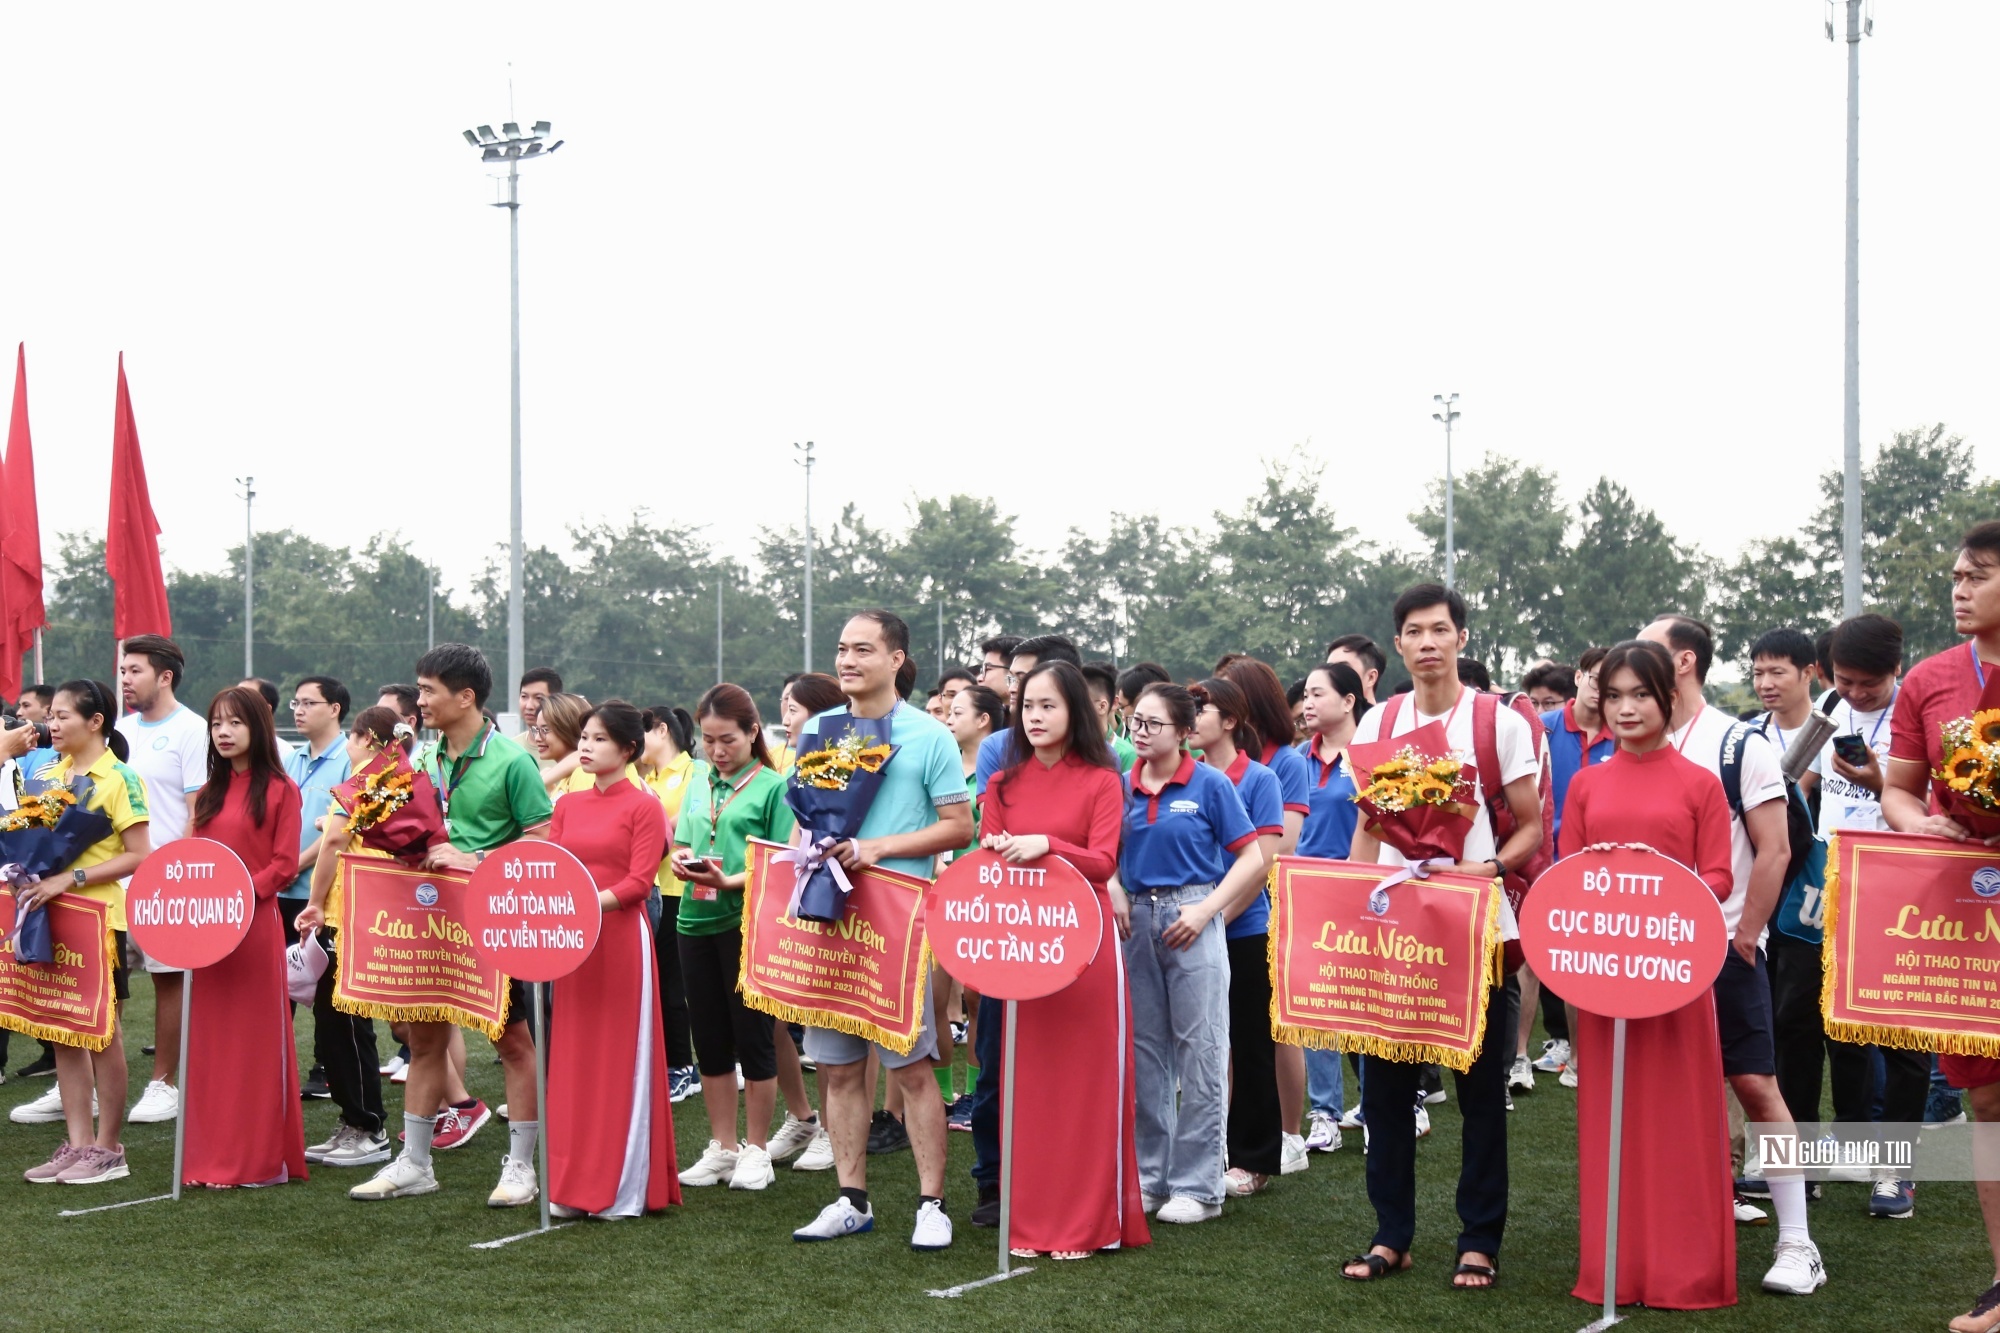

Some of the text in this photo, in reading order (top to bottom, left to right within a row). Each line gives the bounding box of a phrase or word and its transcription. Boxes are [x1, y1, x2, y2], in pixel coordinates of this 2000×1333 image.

[166, 860, 215, 882] BỘ TTTT
[504, 857, 557, 883] BỘ TTTT
[979, 861, 1047, 888] BỘ TTTT
[1583, 867, 1663, 896] BỘ TTTT
[134, 888, 244, 930] KHỐI CƠ QUAN BỘ
[489, 888, 576, 915] KHỐI TÒA NHÀ
[945, 894, 1079, 929] KHỐI TOÀ NHÀ
[368, 910, 418, 939] Lưu
[483, 920, 584, 952] CỤC VIỄN THÔNG
[826, 913, 887, 954] Niệm
[1548, 908, 1695, 946] CỤC BƯU ĐIỆN
[1884, 904, 1969, 942] Lưu
[53, 942, 85, 969] ệm
[373, 944, 477, 969] HỘI THAO TRUYỀN THỐNG
[779, 937, 880, 975] HỘI THAO TRUYỀN THỐNG
[956, 931, 1065, 965] CỤC TẦN SỐ
[1312, 921, 1449, 969] Lưu Niệm
[0, 960, 8, 975] ỘI
[52, 971, 78, 987] THỐNG
[367, 961, 389, 972] NGÀNH
[390, 963, 413, 974] THÔNG
[416, 965, 429, 974] TIN
[430, 964, 441, 974] VÀ
[768, 953, 791, 967] NGÀNH
[791, 959, 813, 973] THÔNG
[815, 965, 827, 976] TIN
[829, 967, 840, 977] VÀ
[1548, 948, 1692, 984] TRUNG ƯƠNG
[1895, 950, 2000, 973] HỘI THAO TRUY
[355, 972, 366, 981] KHU
[380, 975, 396, 986] PHÍA
[415, 976, 434, 986] NĂM
[435, 977, 452, 987] 2023
[780, 971, 795, 983] PHÍA
[812, 978, 832, 989] NĂM
[833, 981, 853, 993] 2023
[1319, 961, 1337, 980] HỘI
[1339, 966, 1367, 981] THAO
[1399, 971, 1439, 991] THỐNG
[1883, 973, 1998, 993] NGÀNH THÔNG TIN VÀ
[1293, 995, 1309, 1006] KHU
[1310, 997, 1326, 1009] VỰC
[1328, 998, 1348, 1010] PHÍA
[1350, 999, 1366, 1012] BẮC
[1309, 981, 1338, 995] NGÀNH
[1340, 984, 1366, 998] THÔNG
[1416, 994, 1447, 1009] THÔNG
[1859, 988, 1880, 1000] KHU
[1883, 990, 1904, 1003] VỰC
[1906, 991, 1932, 1004] PHÍA
[1935, 990, 1958, 1006] BẮC
[1961, 994, 1987, 1009] NĂM
